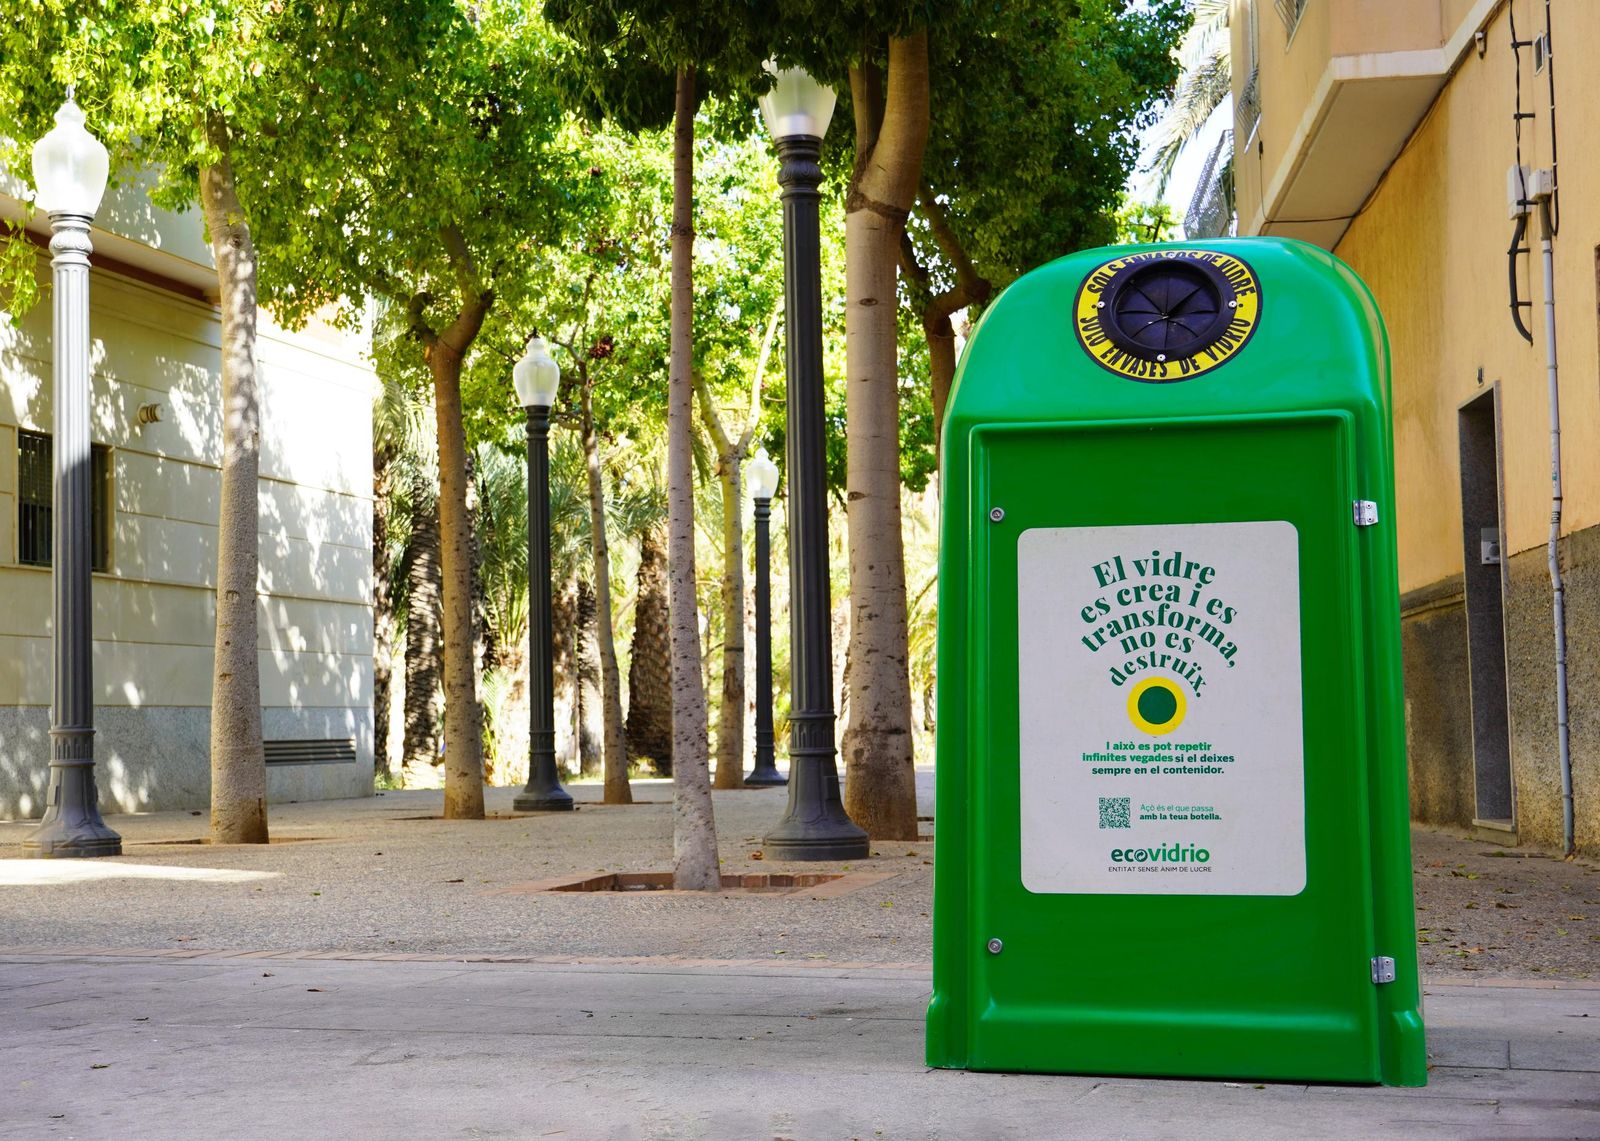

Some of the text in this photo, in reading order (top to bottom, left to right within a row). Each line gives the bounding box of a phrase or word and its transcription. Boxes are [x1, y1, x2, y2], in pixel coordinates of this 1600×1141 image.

[1100, 346, 1167, 378] ENVASES
[1178, 356, 1201, 375] DE
[1205, 318, 1251, 362] VIDRIO
[1092, 550, 1215, 588] El vidre
[1081, 583, 1237, 624] es crea i es
[1081, 603, 1238, 668] transforma,
[1120, 631, 1195, 654] no es
[1109, 651, 1206, 698] destruïx.
[1083, 753, 1127, 762] infinites
[1130, 754, 1173, 764] vegades
[1187, 754, 1197, 763] el
[1200, 754, 1235, 763] deixes
[1113, 741, 1135, 750] això
[1153, 742, 1172, 753] pot
[1175, 742, 1212, 753] repetir
[1092, 768, 1131, 776] sempre
[1151, 766, 1160, 774] el
[1163, 766, 1224, 774] contenidor.
[1111, 843, 1210, 863] ecovidrio
